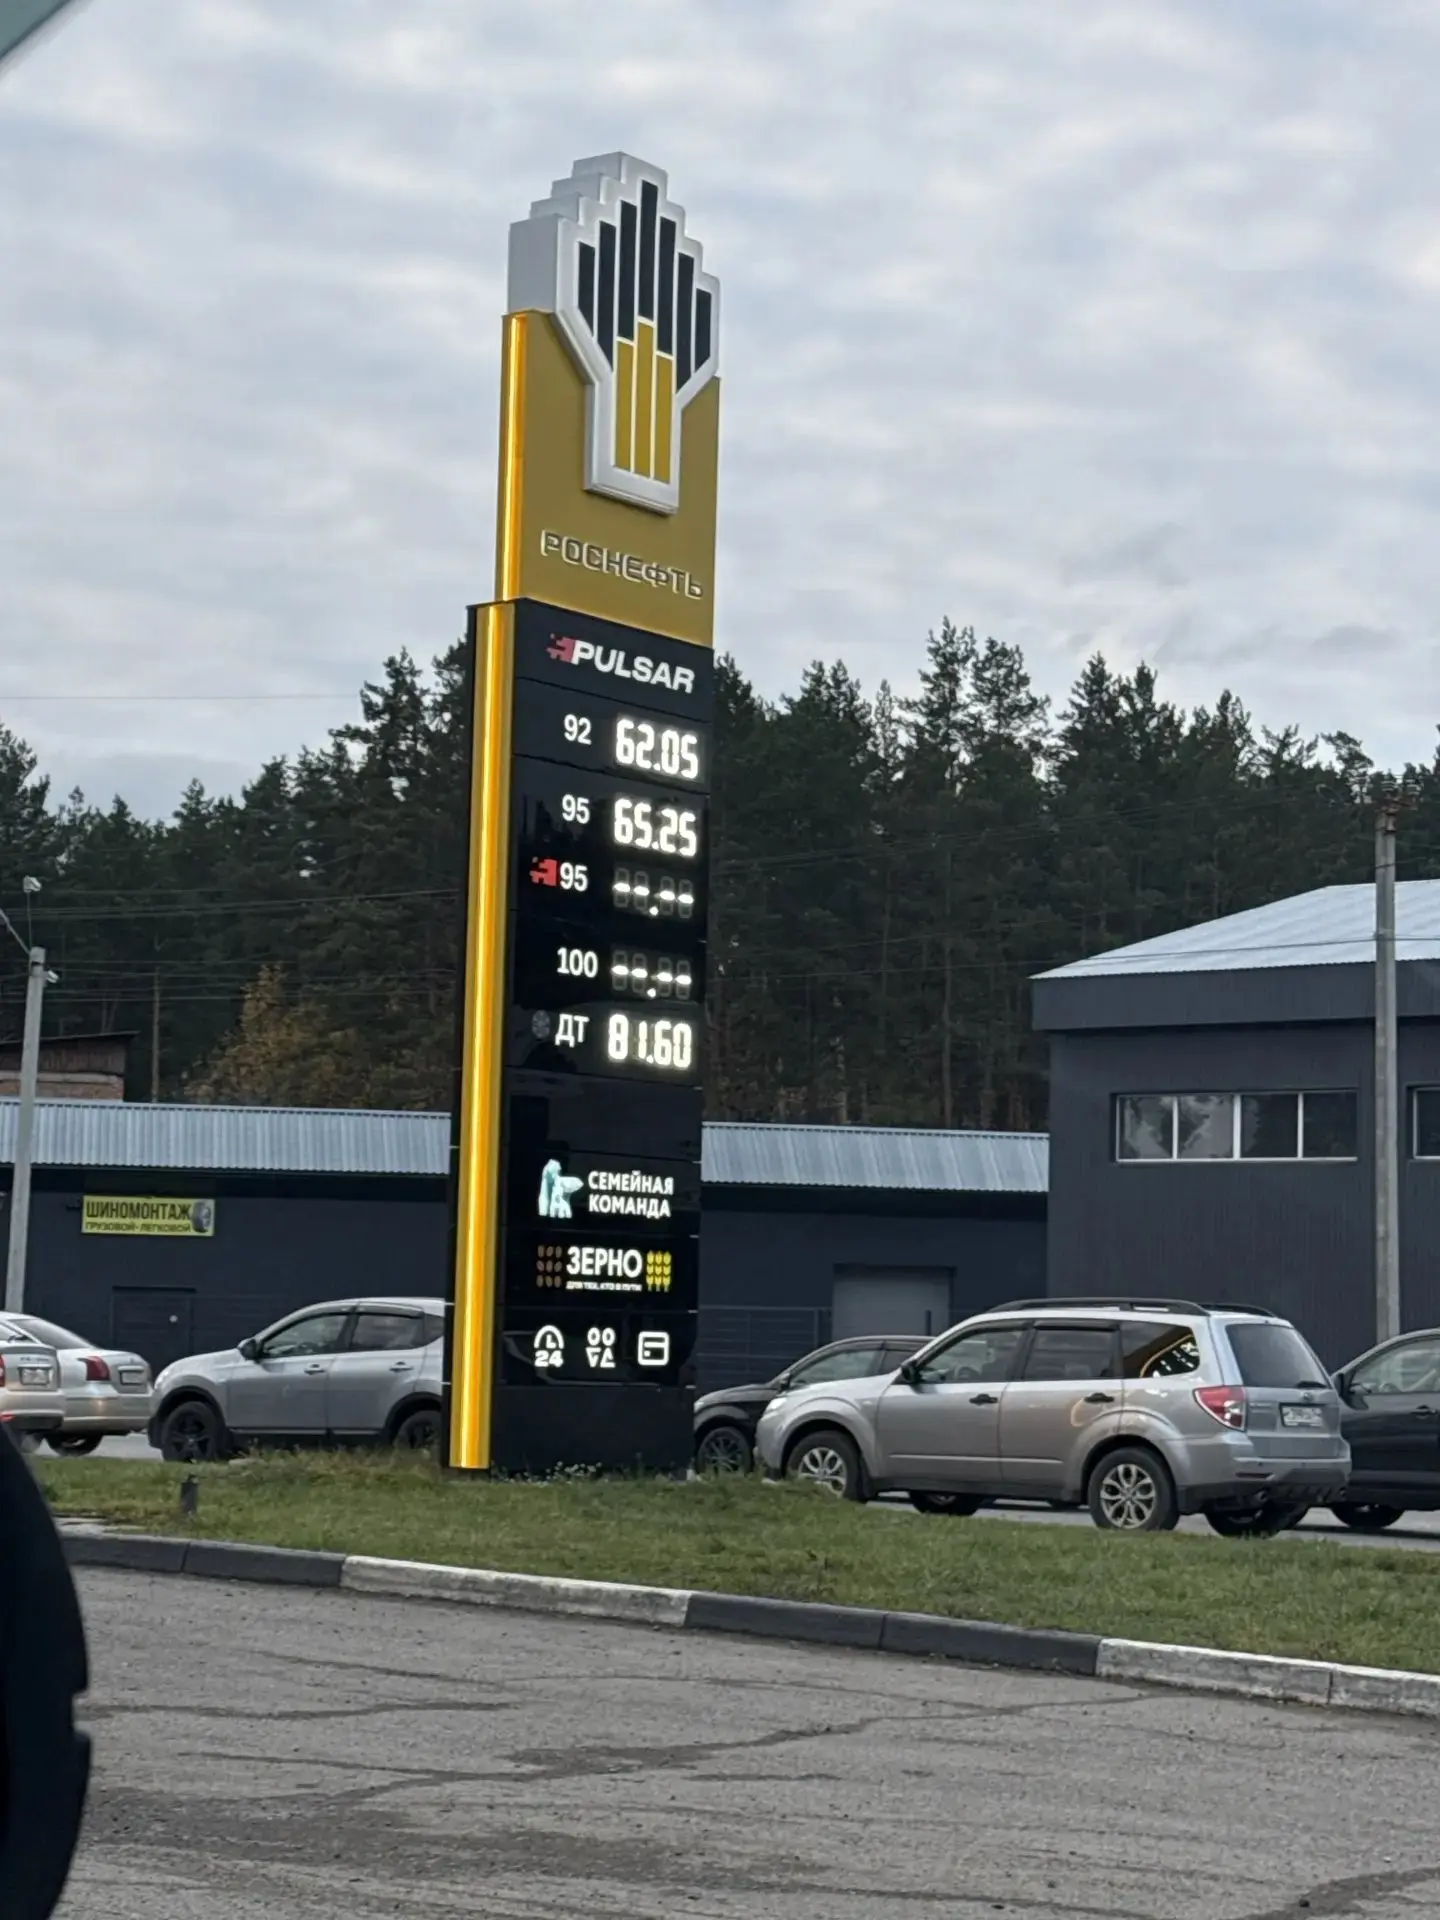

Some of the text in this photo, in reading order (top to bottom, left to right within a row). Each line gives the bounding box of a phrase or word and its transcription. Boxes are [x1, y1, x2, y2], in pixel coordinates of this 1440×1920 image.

[540, 529, 703, 600] РОСНЕФТЬ
[571, 639, 696, 694] PULSAR
[563, 714, 699, 779] 92 62.05
[561, 793, 698, 858] 95 65.25
[559, 862, 588, 892] 95
[556, 946, 599, 979] 100
[554, 1013, 692, 1069] ДТ 81.60
[588, 1170, 674, 1196] СЕМЕЙНАЯ
[86, 1201, 191, 1221] ШИНОМОНТАЖ
[588, 1194, 671, 1219] КОМАНДА
[566, 1246, 643, 1278] ЗЕРНО
[534, 1350, 564, 1367] 24
